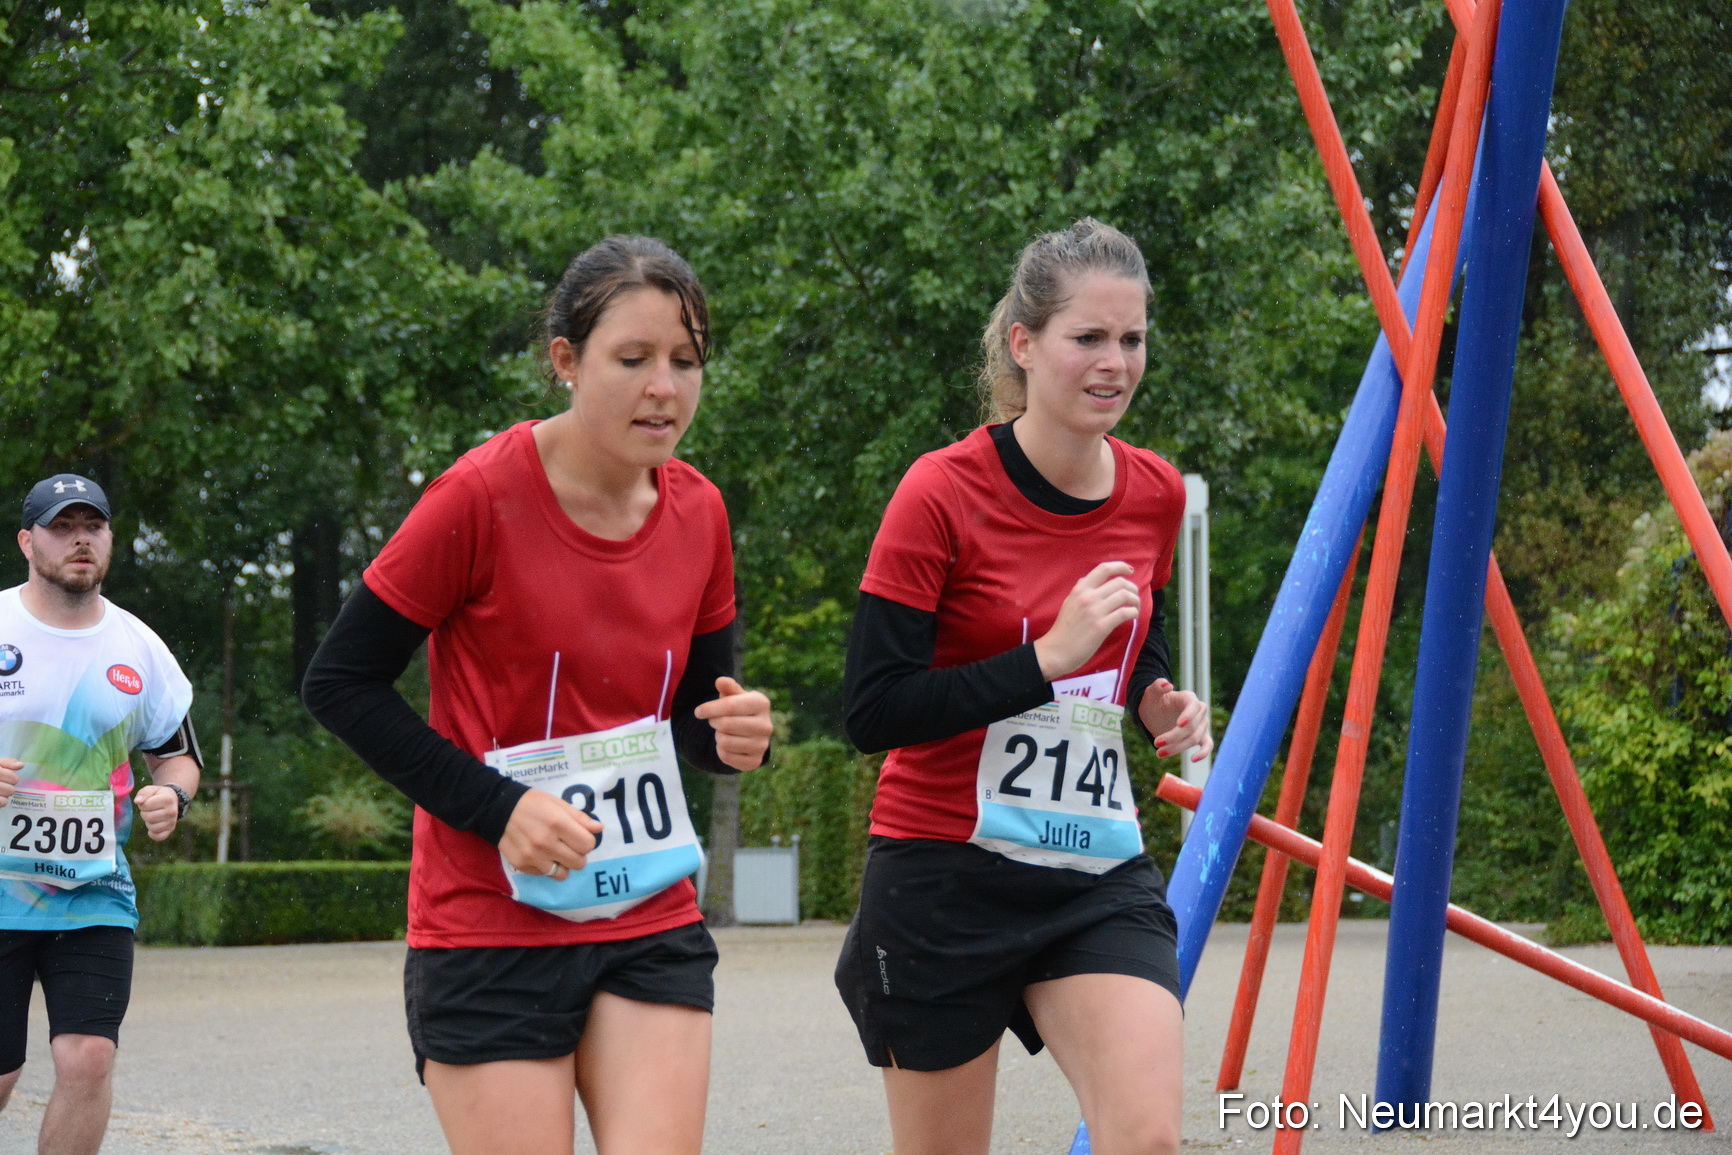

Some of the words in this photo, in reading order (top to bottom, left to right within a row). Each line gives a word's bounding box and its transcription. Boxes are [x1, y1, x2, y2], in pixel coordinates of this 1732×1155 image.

[112, 669, 140, 689] Hervis
[580, 731, 660, 765] BOCK
[505, 761, 569, 779] NeuerMarkt
[998, 733, 1123, 811] 2142
[10, 799, 47, 809] NeuerMarkt
[53, 795, 106, 808] BOCK
[985, 789, 992, 800] B
[10, 814, 105, 855] 2303
[1039, 820, 1091, 849] Julia
[34, 862, 76, 879] Heiko
[594, 867, 630, 898] Evi
